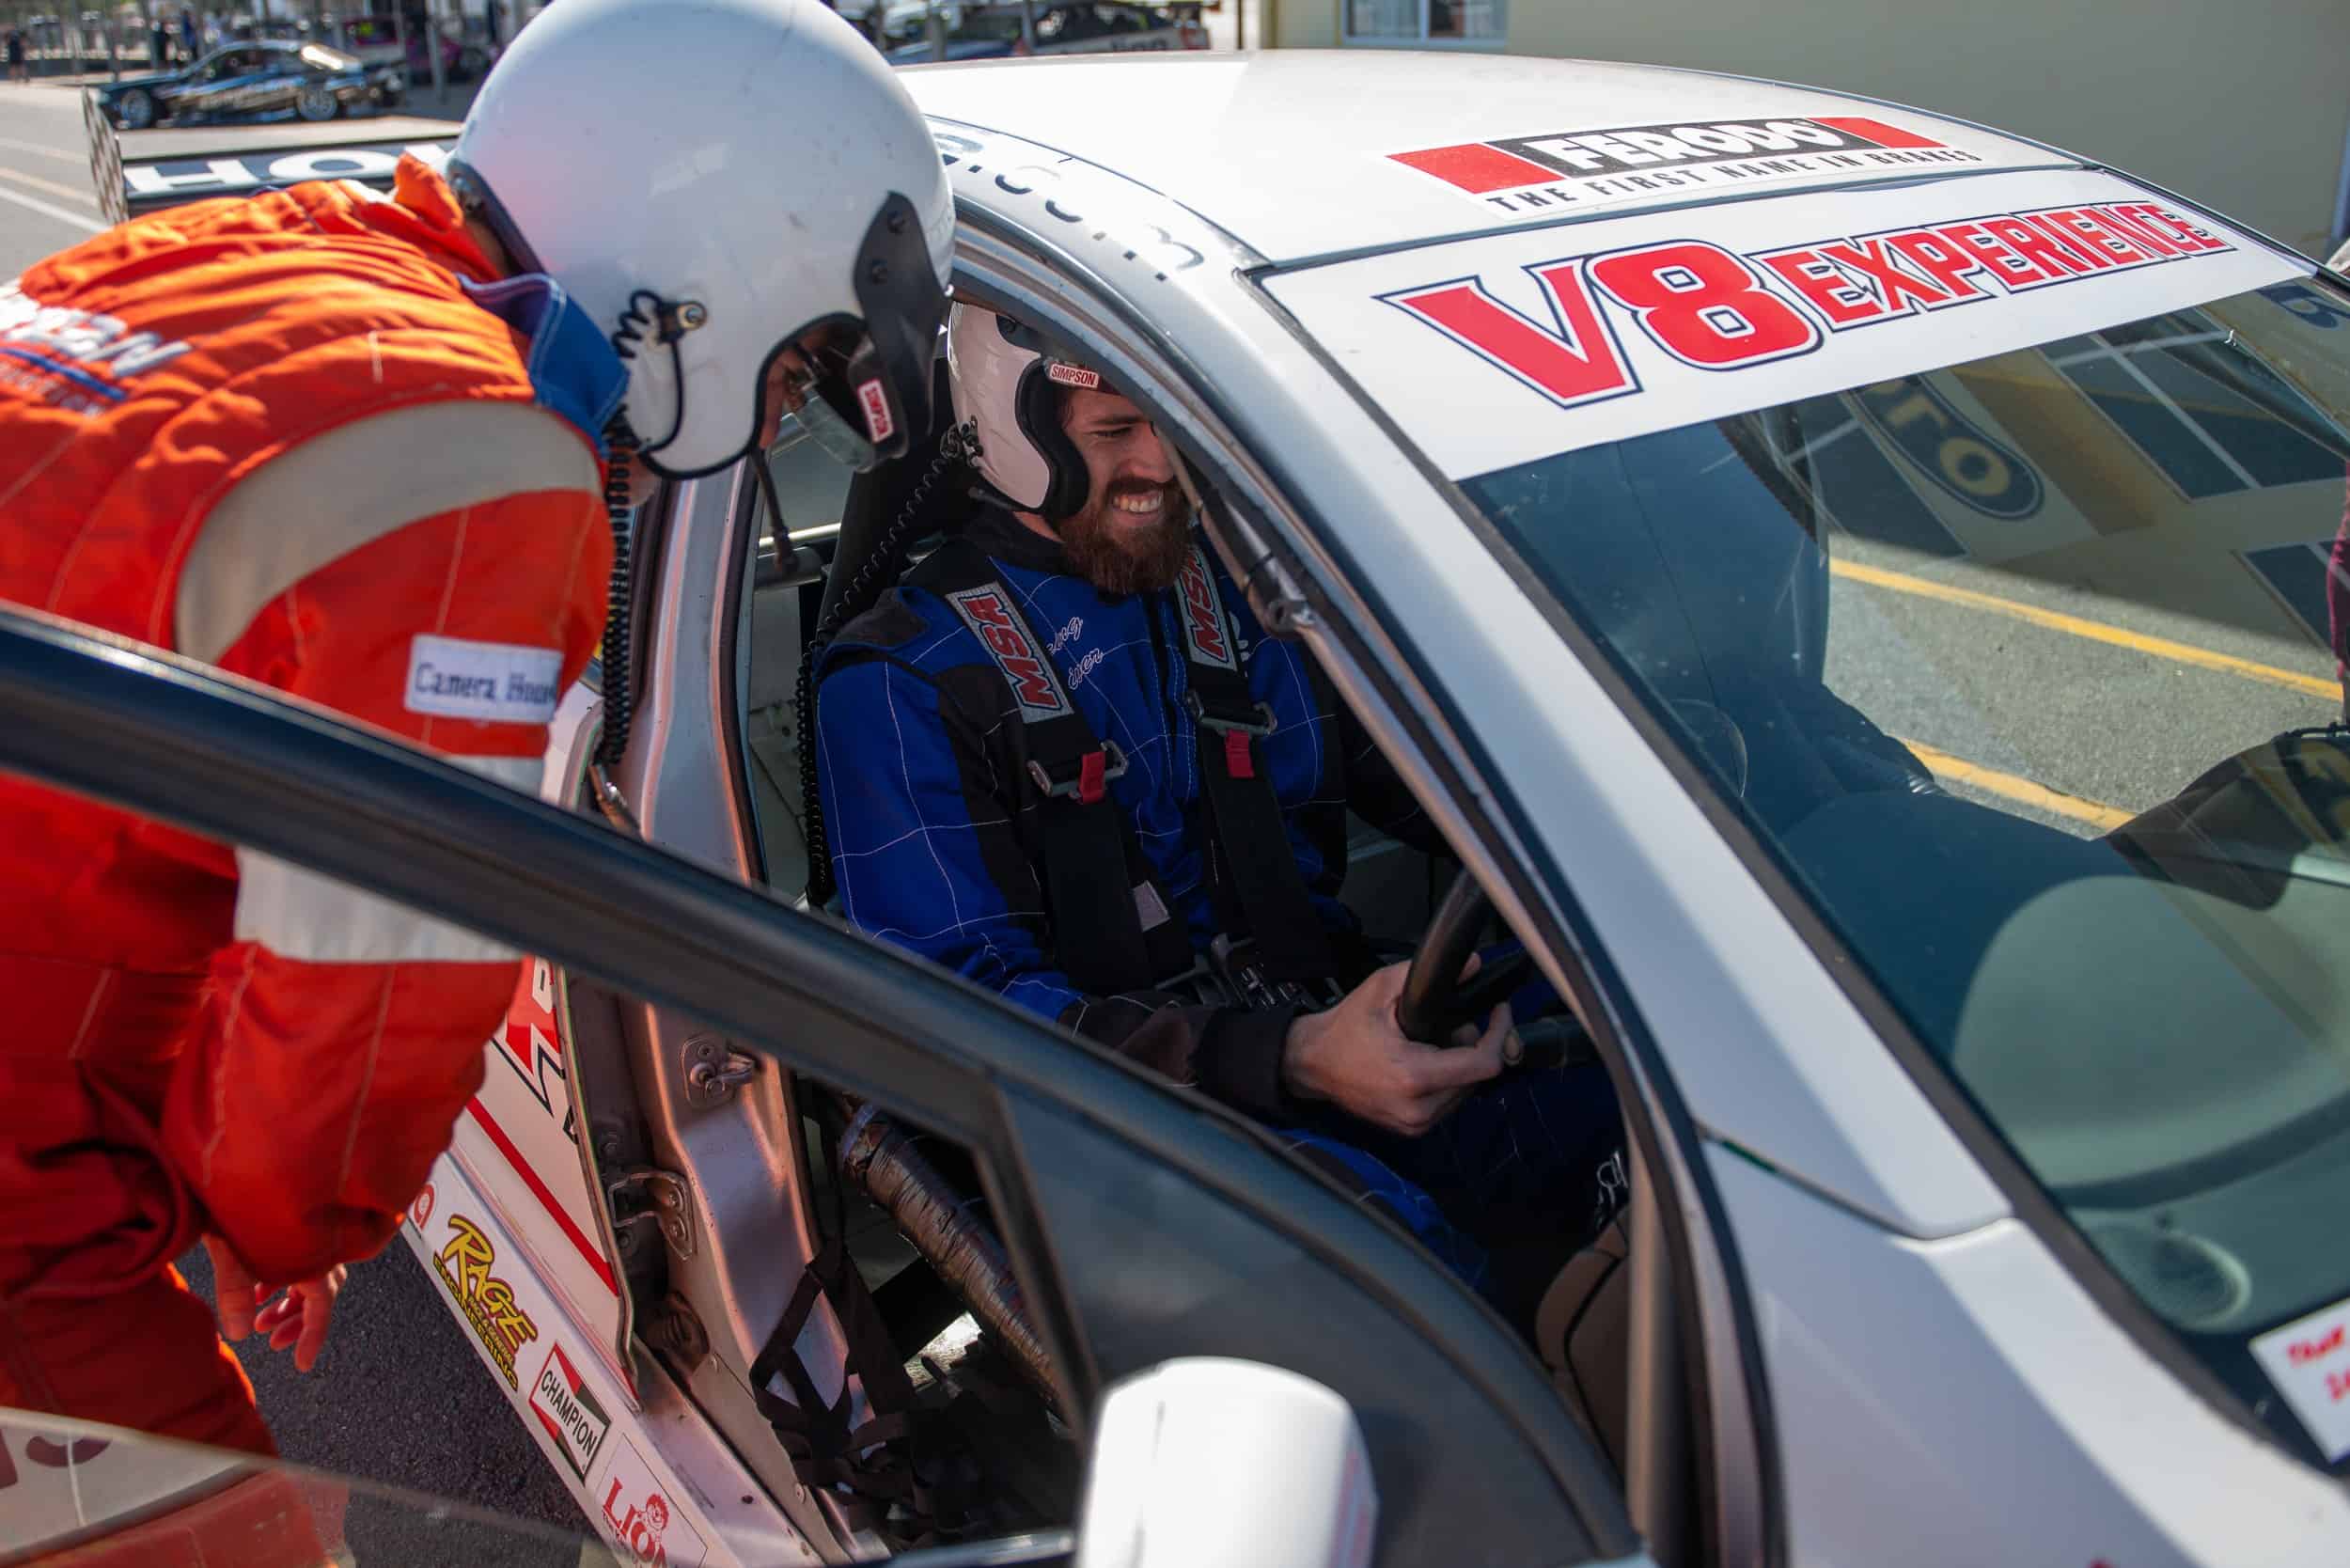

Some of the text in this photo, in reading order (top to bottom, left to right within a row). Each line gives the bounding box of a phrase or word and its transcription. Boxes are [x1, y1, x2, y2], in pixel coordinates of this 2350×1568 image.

[1485, 149, 1983, 212] THE FIRST NAME IN BRAKES
[1521, 121, 1843, 170] FERODO
[1371, 201, 2238, 411] V8 EXPERIENCE
[1051, 365, 1097, 385] SIMPSON
[415, 661, 496, 700] Camera
[960, 593, 1060, 711] MSA
[432, 1252, 519, 1392] ENGINEERING
[442, 1213, 539, 1354] RAGE
[540, 1369, 599, 1458] CHAMPION
